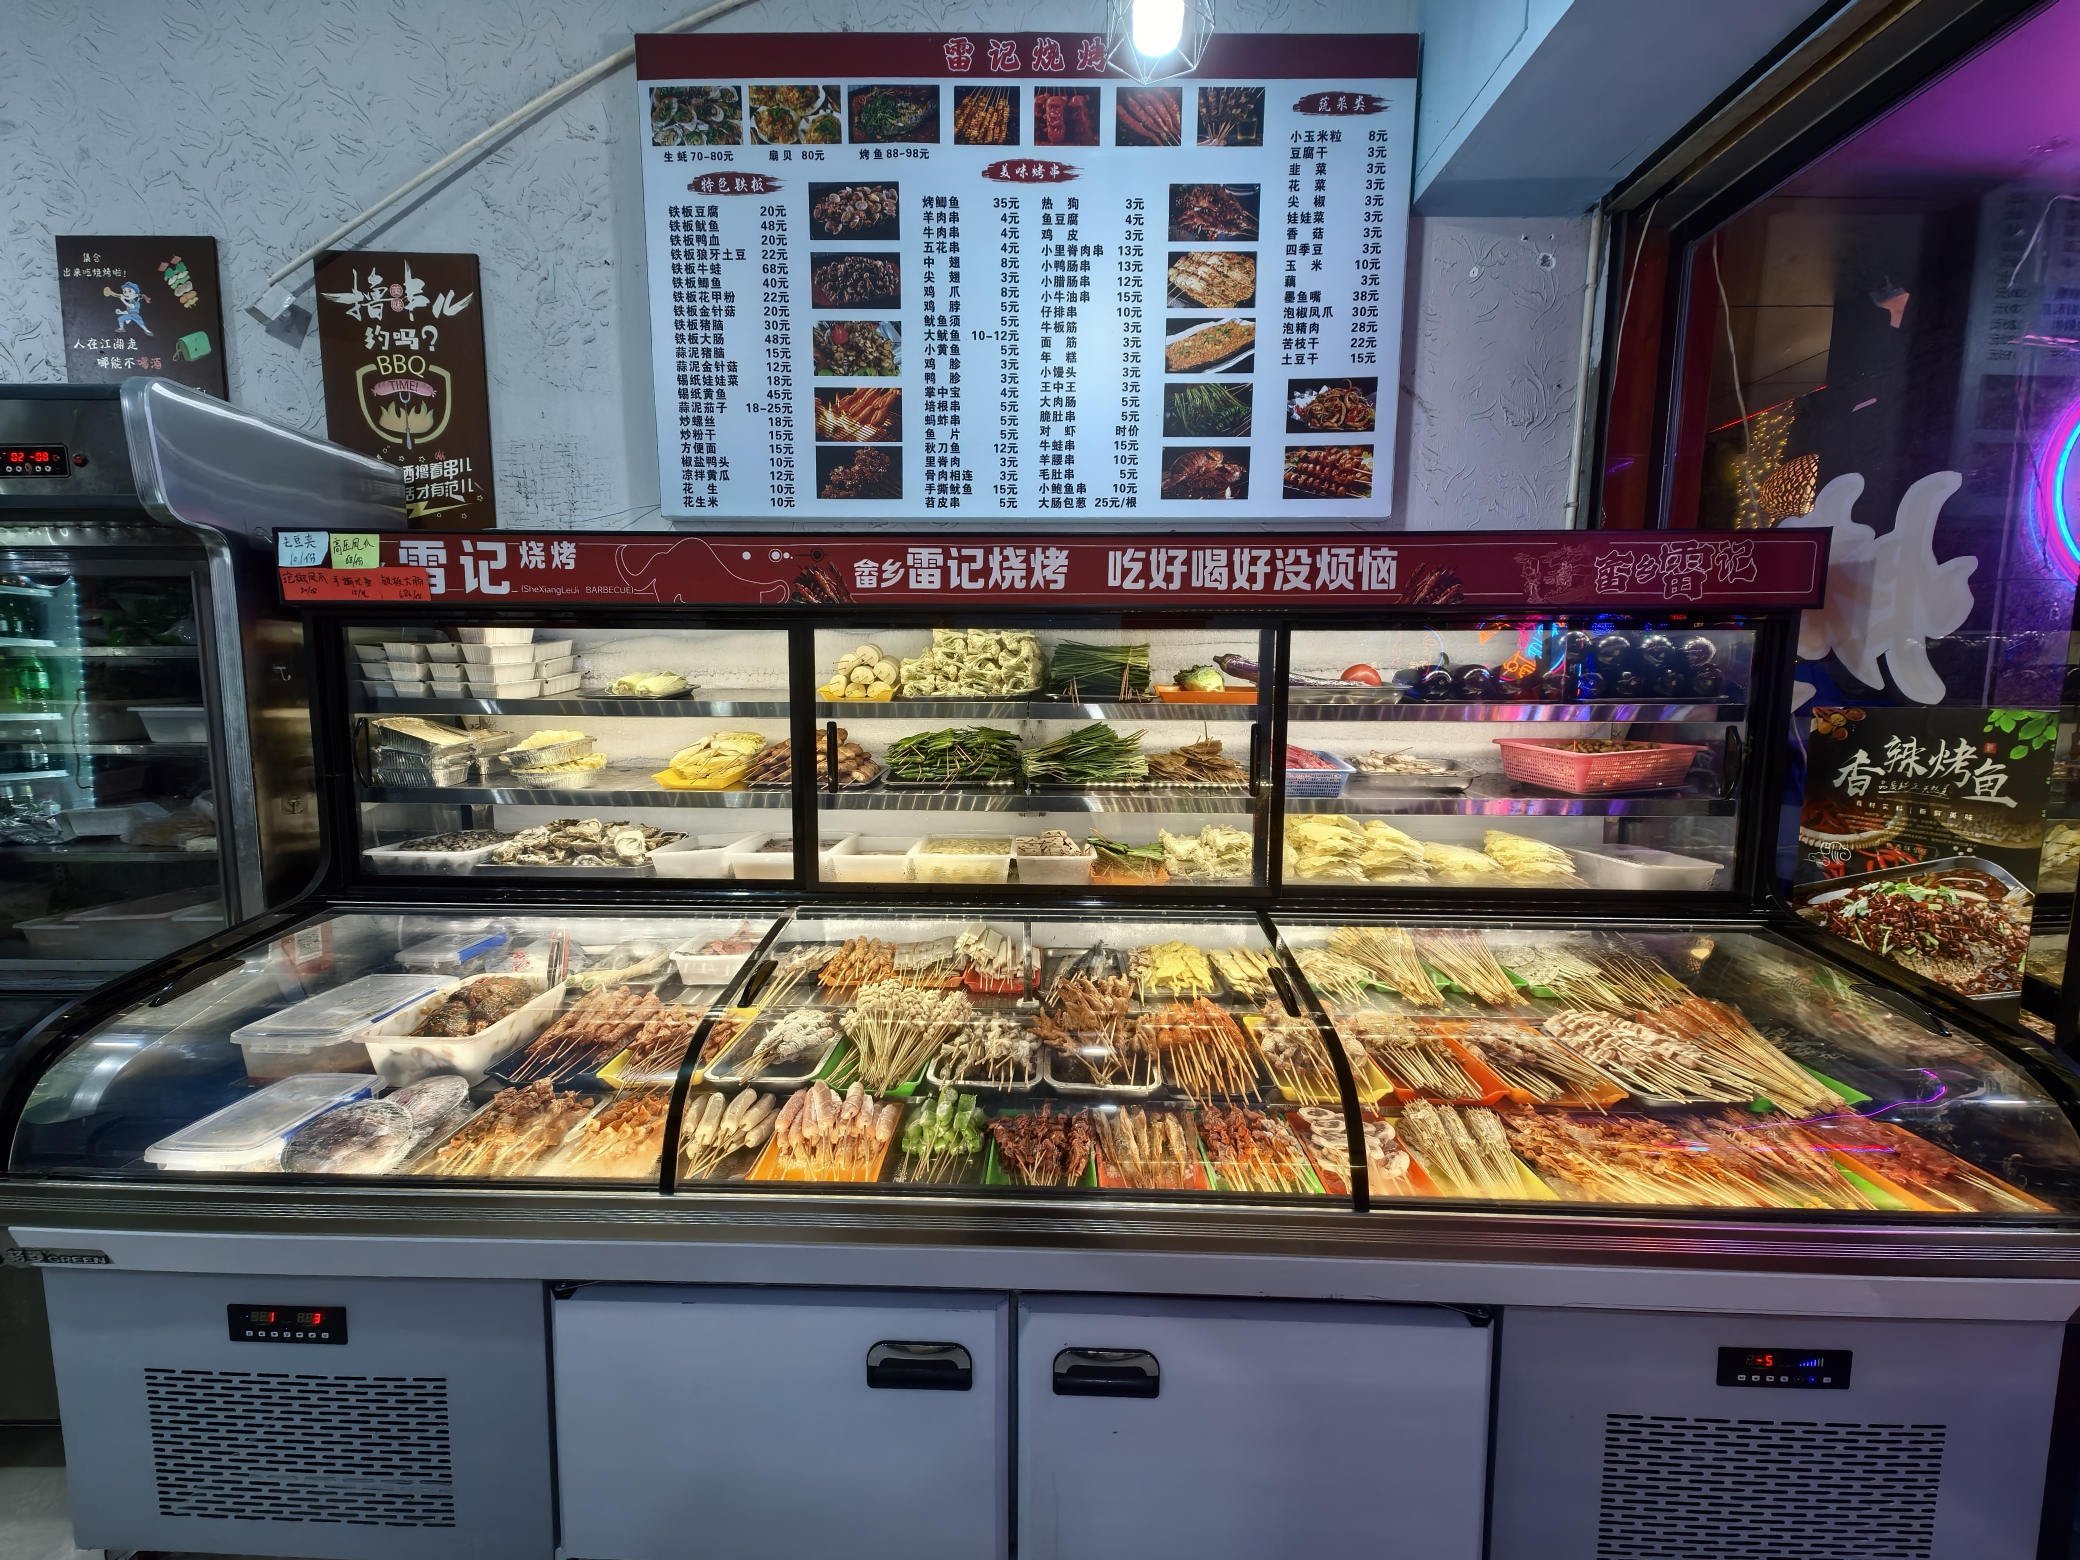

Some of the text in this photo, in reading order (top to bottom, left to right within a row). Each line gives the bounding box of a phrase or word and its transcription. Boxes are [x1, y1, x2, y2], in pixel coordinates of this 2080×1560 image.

[943, 36, 1108, 72] 雷记烧烤
[1318, 95, 1366, 112] 蔬菜类
[1290, 129, 1388, 143] 小玉米粒 8元
[690, 150, 734, 162] 70-80元
[801, 149, 825, 161] 80元
[859, 148, 930, 160] 烤鱼 88-98元
[1289, 146, 1387, 159] 豆腐干 3元
[1000, 163, 1061, 179] 美味烤串
[921, 196, 1019, 209] 烤鲫鱼 35元
[668, 205, 786, 218] 铁板豆腐 20元
[922, 211, 1019, 224] 羊肉串 4元
[1286, 211, 1383, 224] 娃娃菜 3元
[1041, 213, 1144, 225] 鱼豆腐 4元
[668, 220, 787, 232] 铁板鱿鱼 48元
[922, 226, 1019, 239] 牛肉串 4元
[669, 234, 787, 247] 铁板鸭血 20元
[922, 241, 1019, 254] 五花串 4元
[1041, 244, 1143, 257] 小里脊肉串 13元
[1285, 243, 1381, 256] 四季豆 3元
[670, 248, 788, 261] 铁板狼牙土豆 22元
[670, 262, 788, 275] 铁板牛蛙 68元
[1041, 259, 1143, 272] 小鸭肠串 13元
[1040, 275, 1143, 288] 小腊肠串 12元
[672, 291, 789, 303] 铁板花甲粉 22元
[1040, 290, 1142, 303] 小牛油串 15元
[673, 305, 790, 317] 铁板金针菇 20元
[1040, 306, 1142, 318] 仔排串 10元
[1282, 306, 1378, 319] 泡椒凤爪 30元
[673, 319, 790, 331] 铁板猪脑 30元
[923, 314, 1019, 327] 鱿鱼须 5元
[1040, 321, 1141, 333] 牛板筋 3元
[1282, 321, 1378, 334] 泡精肉 28元
[674, 333, 791, 345] 铁板大肠 48元
[923, 329, 1019, 341] 大鱿鱼 10-12元
[73, 338, 139, 350] 人在江湖走
[924, 343, 1019, 356] 小黄鱼 5元
[97, 356, 162, 370] 哪能不喝酒
[1280, 352, 1376, 365] 土豆干 15元
[377, 354, 426, 378] BBQ
[675, 360, 791, 373] 蒜泥金针菇 12元
[388, 380, 419, 392] TIME!
[676, 374, 792, 386] 锡纸娃娃菜 18元
[677, 387, 792, 400] 锡纸黄鱼 45元
[924, 386, 1019, 398] 掌中宝 4元
[1039, 381, 1140, 393] 王中王 3元
[678, 401, 793, 414] 蒜泥茄子 18-25元
[924, 400, 1018, 412] 培根串 5元
[1039, 396, 1140, 407] 大肉肠 5元
[678, 415, 793, 428] 炒螺丝 18元
[1039, 410, 1139, 422] 脆肚串 5元
[679, 428, 793, 441] 炒粉干 15元
[680, 442, 794, 454] 方便面 15元
[924, 442, 1018, 454] 秋刀鱼 12元
[1038, 439, 1139, 451] 牛蛙串 15元
[680, 455, 794, 468] 椒盐鸭头 10元
[924, 456, 1018, 468] 里脊肉 3元
[681, 469, 794, 481] 凉拌黄瓜 12元
[924, 469, 1018, 481] 骨肉相连 3元
[1038, 468, 1138, 480] 毛肚串 5元
[924, 483, 1018, 495] 手撕鱿鱼 15元
[1038, 482, 1137, 494] 小鲍鱼串 10元
[682, 496, 795, 508] 花生米 10元
[1038, 496, 1136, 508] 大肠包葱 25元/根
[519, 540, 577, 570] 烧烤
[1107, 547, 1398, 591] 吃好喝好没烦恼
[1833, 735, 2018, 808] 香辣烤鱼
[312, 1312, 321, 1324] 3
[1755, 1355, 1773, 1367] -5
